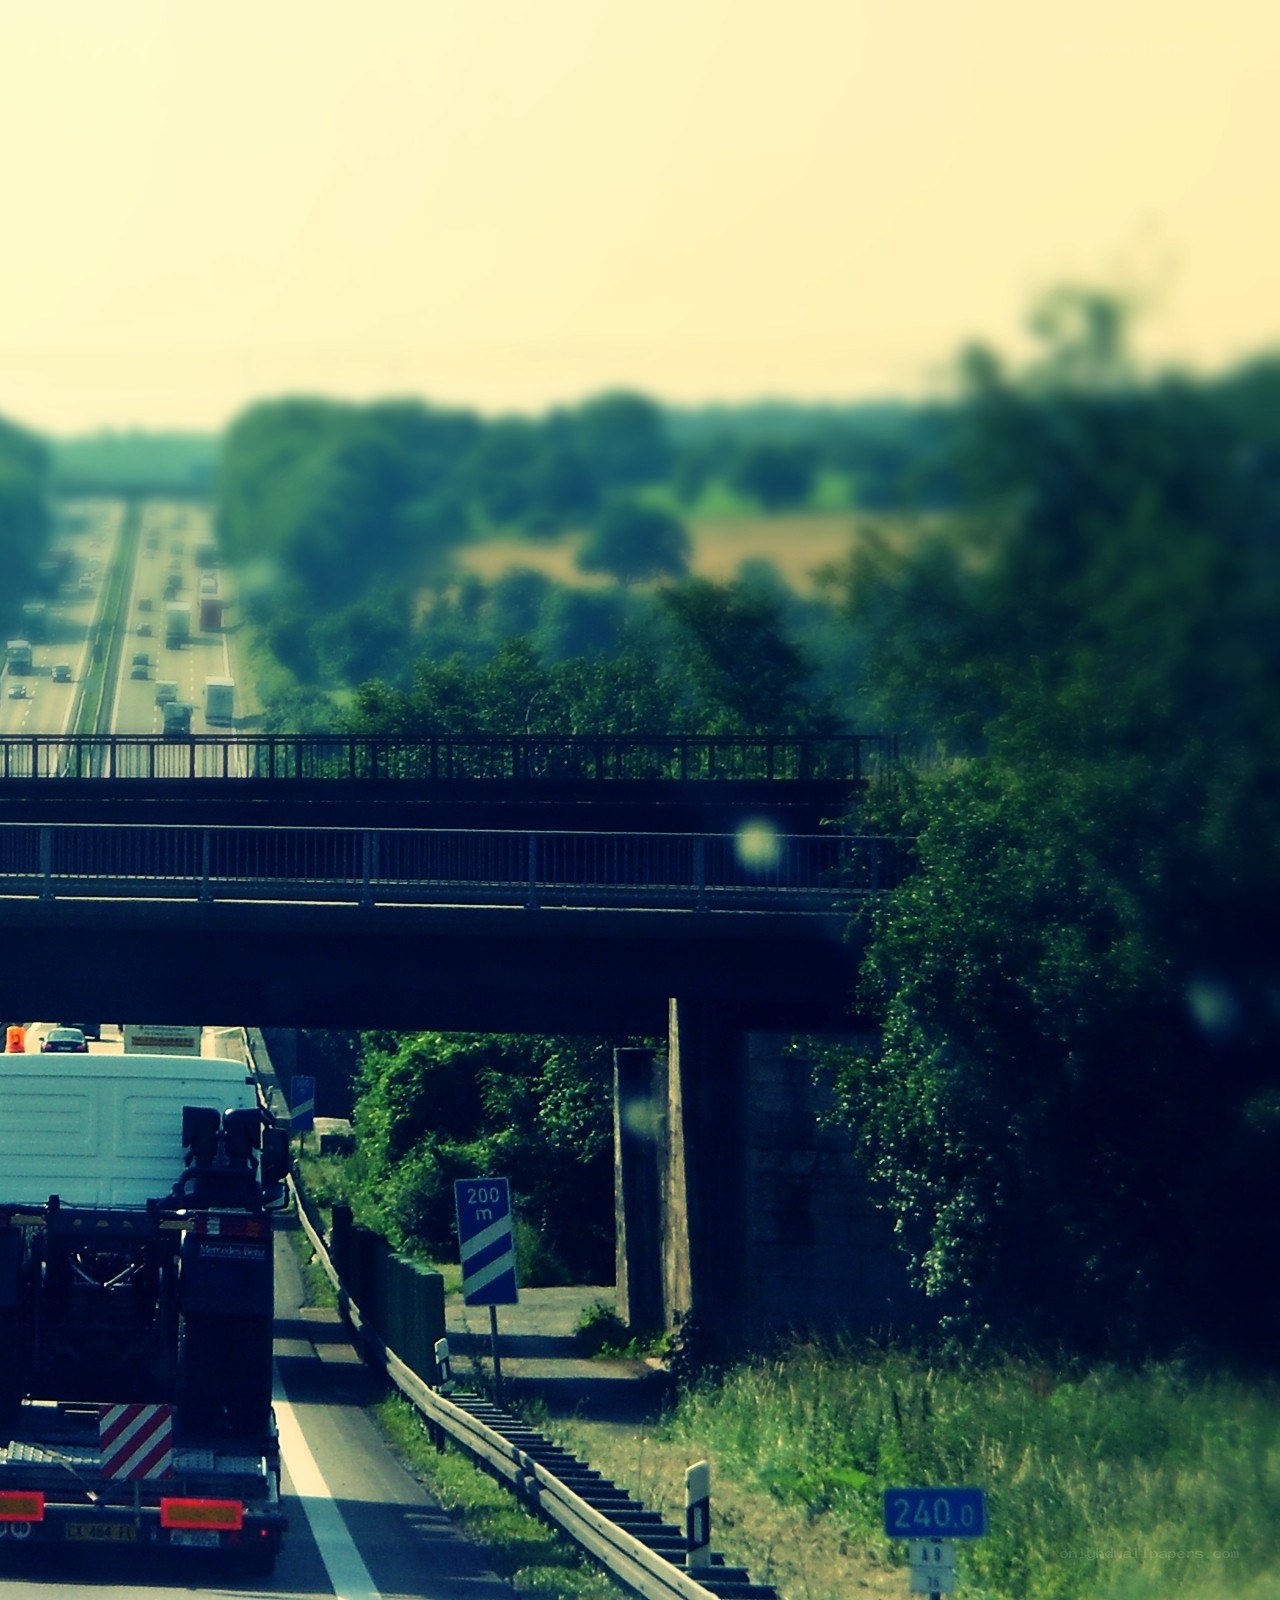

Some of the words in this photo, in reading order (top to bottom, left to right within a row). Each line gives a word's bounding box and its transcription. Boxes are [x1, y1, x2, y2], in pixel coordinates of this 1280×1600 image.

[467, 1187, 500, 1204] 200
[475, 1208, 493, 1221] m
[894, 1497, 973, 1528] 240.0
